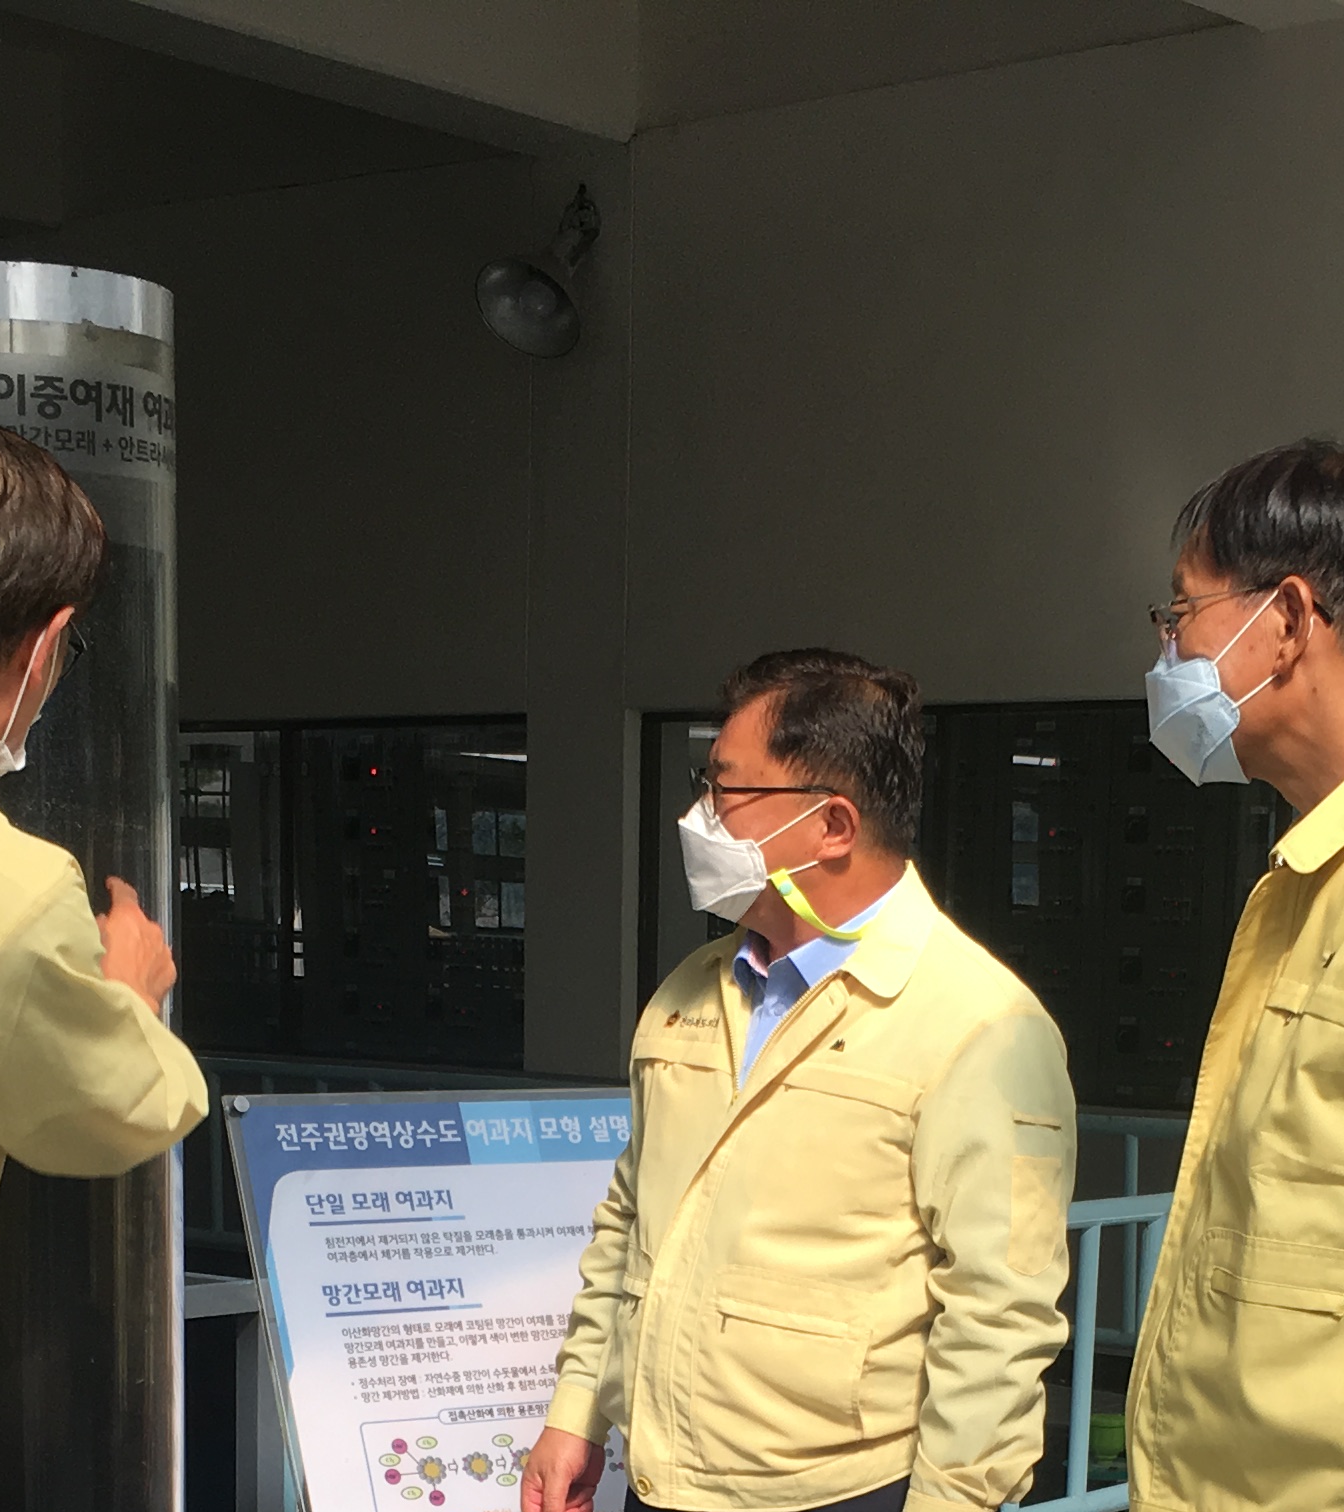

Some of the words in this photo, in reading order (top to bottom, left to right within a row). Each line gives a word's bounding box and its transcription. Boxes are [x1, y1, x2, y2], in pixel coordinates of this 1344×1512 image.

[118, 435, 174, 468] 안트라
[274, 1120, 462, 1152] 전주권광역상수도
[465, 1117, 534, 1147] 여과지
[538, 1115, 583, 1144] 모형
[588, 1114, 631, 1143] 설명
[305, 1193, 346, 1215] 단일
[351, 1191, 391, 1213] 모래
[395, 1189, 454, 1212] 여과지
[325, 1234, 377, 1250] 침전지에서
[378, 1232, 419, 1247] 제거되지
[327, 1250, 379, 1263] 여과층에서
[413, 1246, 454, 1260] 작용으로
[456, 1243, 499, 1257] 제거한다.
[321, 1281, 403, 1307] 망간모래
[406, 1277, 465, 1301] 여과지
[341, 1324, 401, 1339] 이산화망간의
[435, 1320, 464, 1333] 모래에
[496, 1316, 525, 1330] 망간이
[344, 1340, 383, 1355] 망간모래
[385, 1337, 425, 1351] 여과지를
[379, 1353, 409, 1367] 망간을
[410, 1350, 454, 1364] 제거한다.
[359, 1376, 396, 1390] 정수처리
[424, 1371, 461, 1384] 자연수중
[463, 1369, 491, 1382] 망간이
[361, 1391, 380, 1404] 망간
[382, 1388, 420, 1401] 제거방법
[466, 1383, 484, 1395] 의한
[486, 1381, 505, 1393] 산화
[507, 1381, 516, 1392] 후
[496, 1406, 515, 1418] 의한
